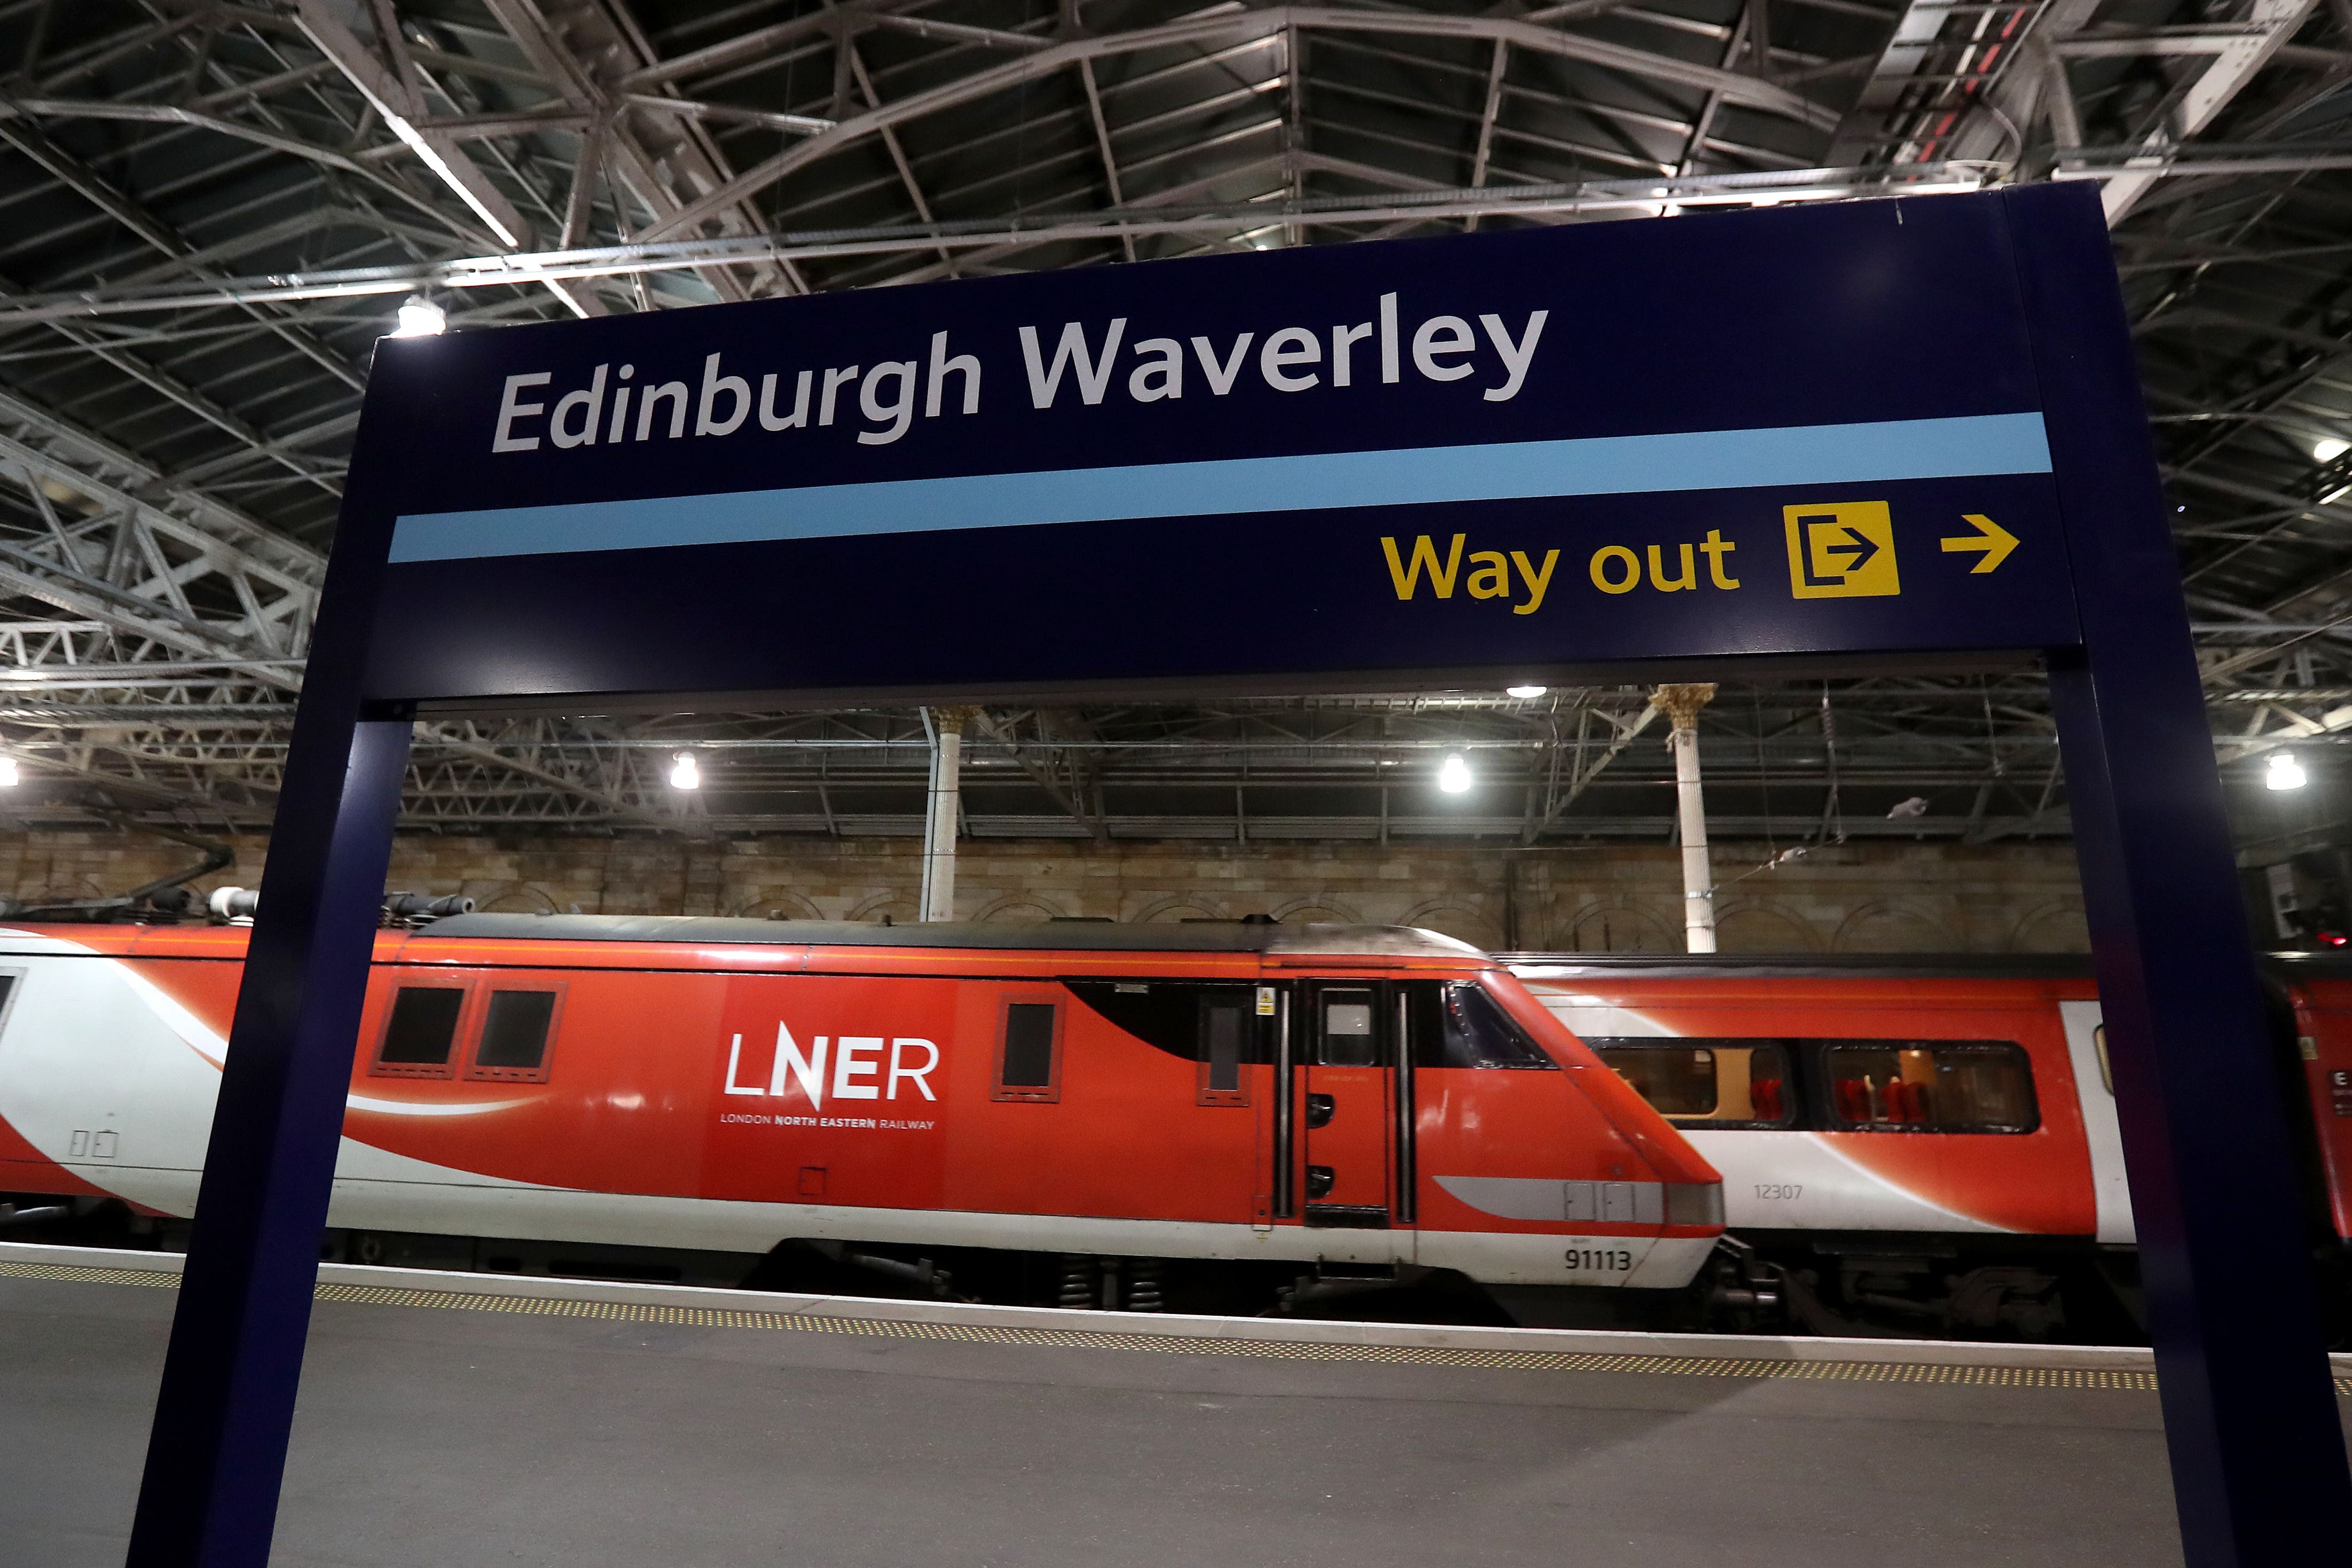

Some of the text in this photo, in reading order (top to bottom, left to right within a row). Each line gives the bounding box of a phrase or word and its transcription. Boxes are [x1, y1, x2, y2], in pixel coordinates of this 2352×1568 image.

[492, 292, 1549, 452] Edinburgh Waverley
[1381, 529, 1740, 615] Way out
[724, 1020, 940, 1112] LNER
[720, 1113, 936, 1130] LONDON NORTH EASTERN RAILWAY
[1754, 1185, 1803, 1199] 12307
[1565, 1249, 1632, 1271] 91113
